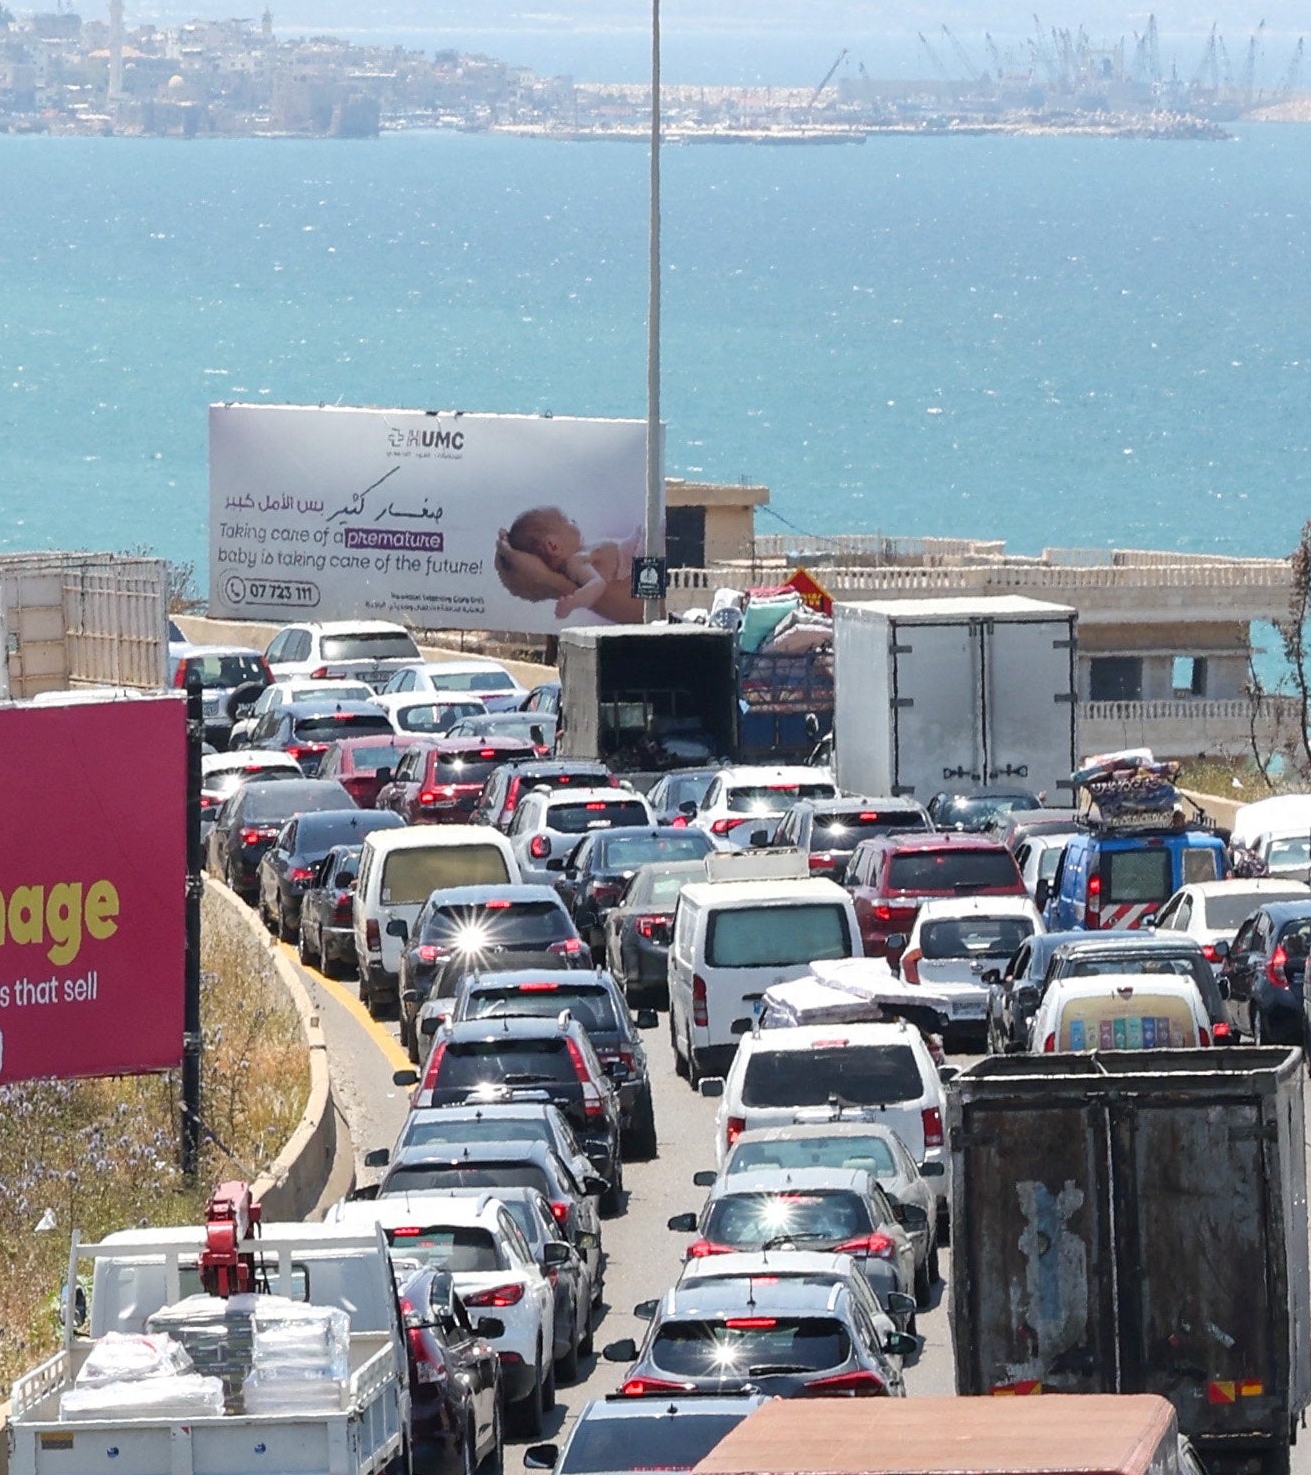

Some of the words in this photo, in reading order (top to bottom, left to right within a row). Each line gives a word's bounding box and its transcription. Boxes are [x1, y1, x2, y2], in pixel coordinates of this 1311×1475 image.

[220, 523, 266, 542] Taking
[271, 528, 309, 542] care
[313, 526, 329, 544] of
[334, 531, 344, 543] a
[346, 528, 441, 548] premature
[218, 548, 257, 567] baby
[261, 549, 274, 565] is
[277, 550, 326, 571] taking
[330, 555, 370, 569] care
[375, 554, 391, 574] of
[395, 556, 421, 572] the
[426, 557, 483, 575] future!
[250, 584, 270, 598] 07
[296, 586, 313, 601] 111
[14, 976, 58, 1006] that
[63, 971, 98, 1001] sell
